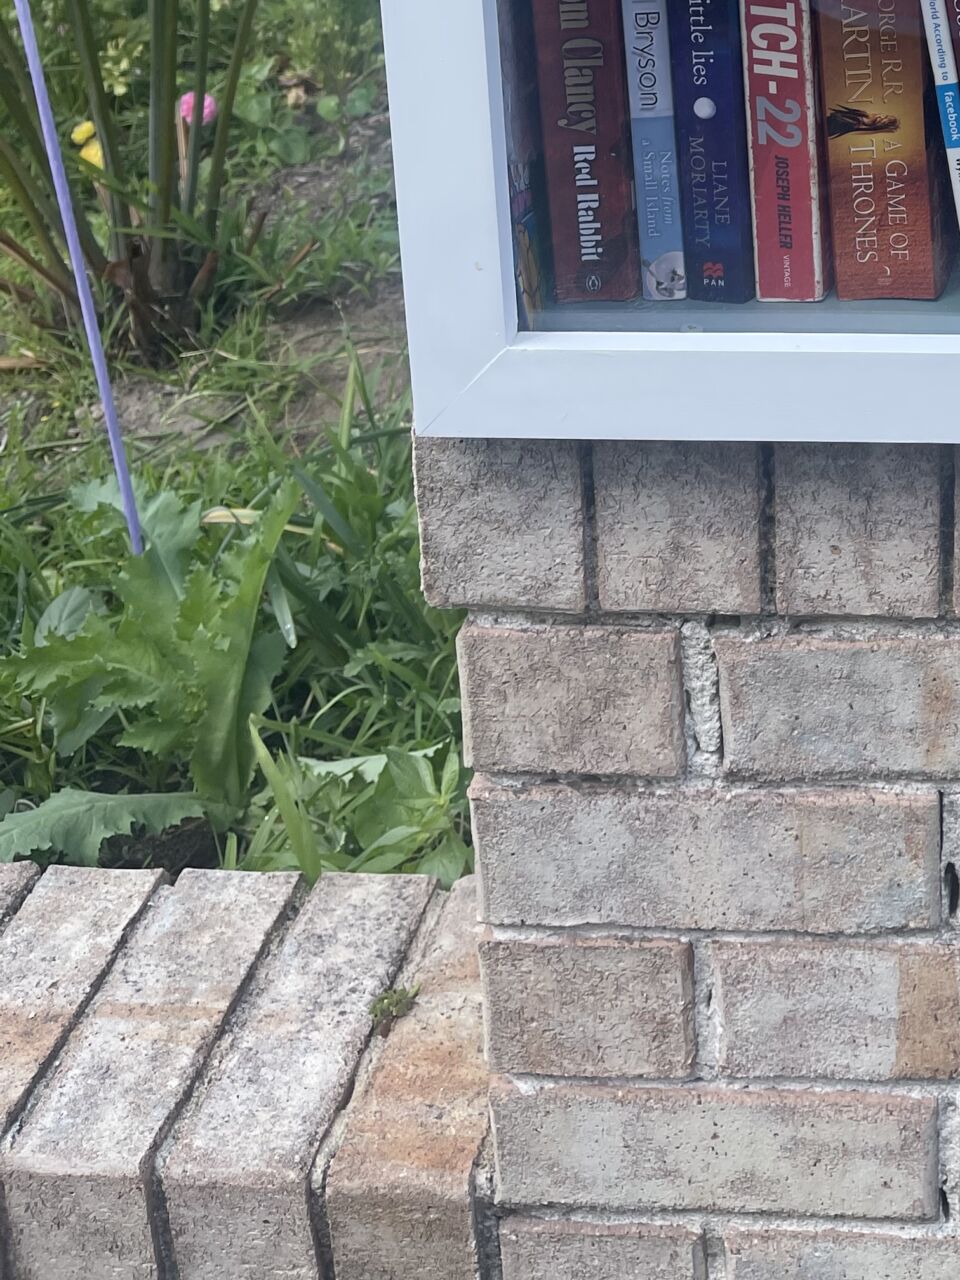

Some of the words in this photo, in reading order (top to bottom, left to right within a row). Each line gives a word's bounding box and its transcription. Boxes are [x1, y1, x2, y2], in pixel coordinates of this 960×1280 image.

[634, 11, 661, 110] Bryson
[691, 52, 716, 86] lies
[932, 22, 948, 69] According
[941, 71, 949, 81] to
[557, 38, 605, 136] Clancy
[943, 91, 960, 143] facebook
[573, 144, 598, 186] Red
[883, 139, 902, 153] A
[642, 151, 658, 191] Small
[660, 151, 673, 193] Notes
[689, 136, 711, 248] MORIARTY
[712, 160, 731, 225] LIANE
[774, 154, 791, 204] JOSEPH
[645, 196, 661, 237] Island
[662, 196, 675, 225] from
[848, 139, 879, 264] THRONES
[884, 160, 909, 230] GAME
[576, 191, 604, 262] Rabbit
[777, 206, 793, 249] HELLER
[890, 237, 910, 261] OF
[703, 278, 725, 287] PAN
[783, 254, 791, 288] VINTAGE
